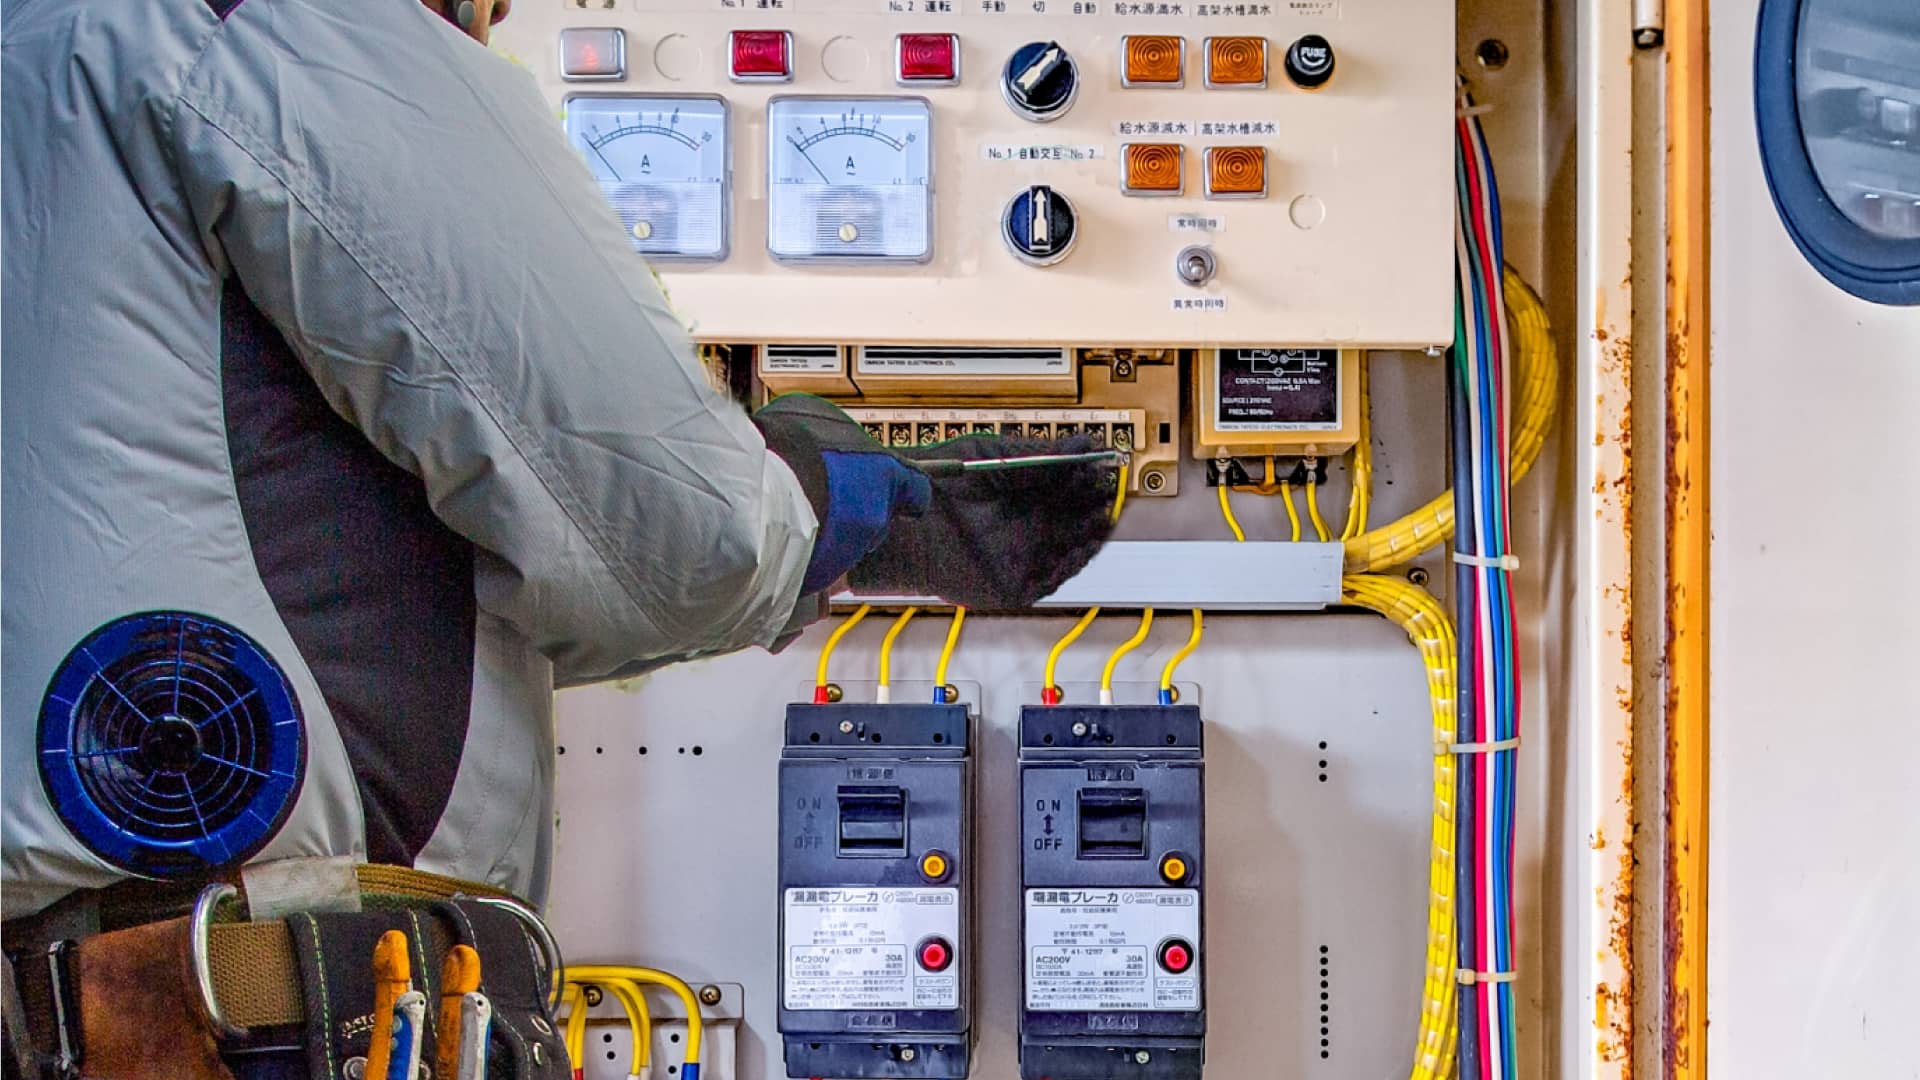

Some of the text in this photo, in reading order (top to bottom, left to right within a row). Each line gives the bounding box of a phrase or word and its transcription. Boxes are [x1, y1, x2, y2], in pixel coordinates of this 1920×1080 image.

[907, 1, 914, 12] 2
[981, 1, 1097, 14] 手動 切 自動
[1300, 46, 1328, 58] FUSE
[1119, 122, 1188, 135] 給水源減水
[1202, 123, 1277, 136] 高架水槽減水
[1007, 148, 1013, 159] 1
[1088, 148, 1095, 159] 2
[640, 154, 651, 168] A
[845, 155, 856, 169] A
[1036, 800, 1061, 811] ON
[794, 836, 823, 849] OFF
[1034, 838, 1063, 850] OFF
[1035, 955, 1071, 964] AC200V
